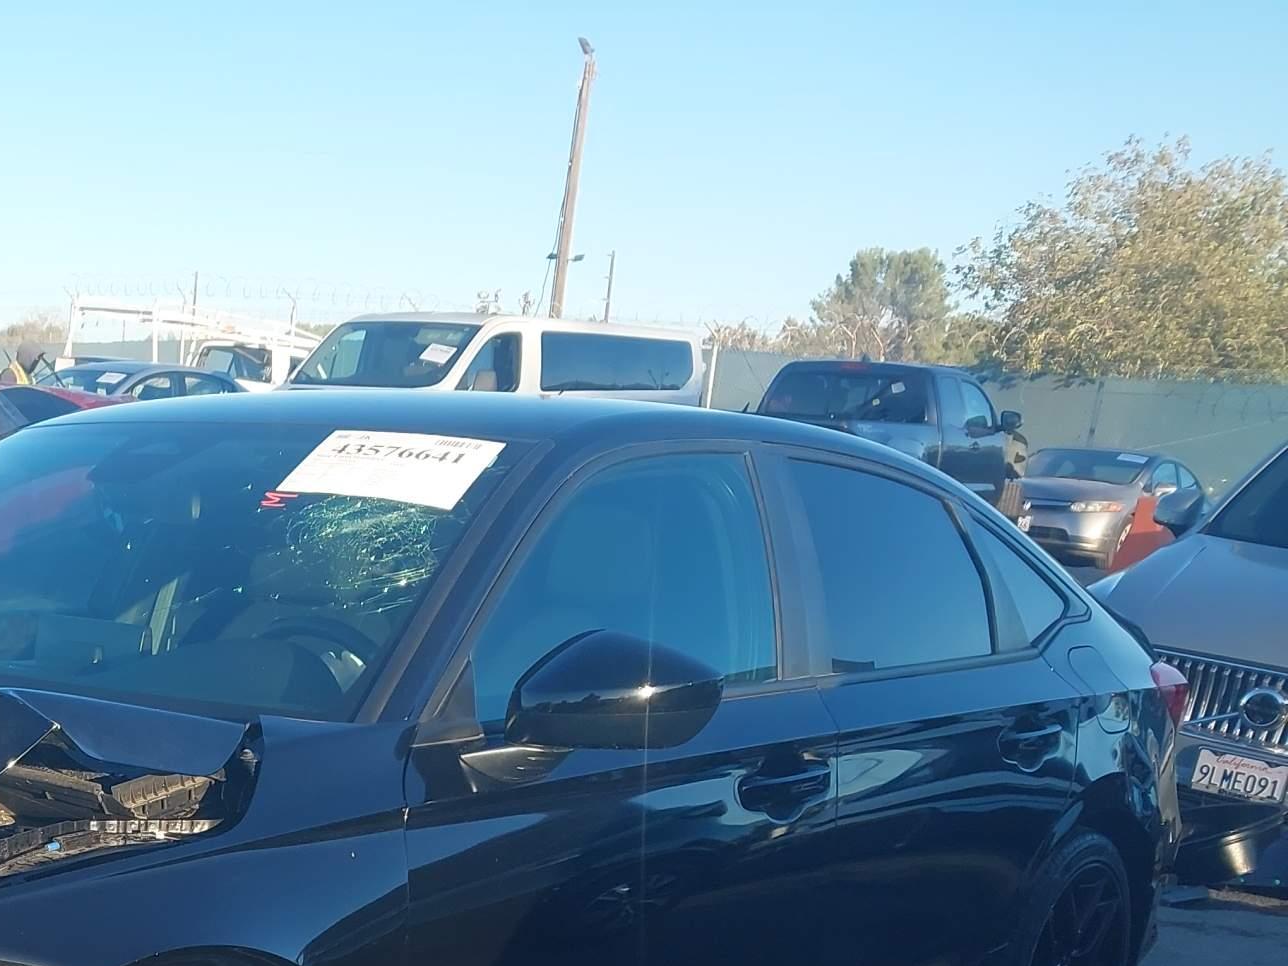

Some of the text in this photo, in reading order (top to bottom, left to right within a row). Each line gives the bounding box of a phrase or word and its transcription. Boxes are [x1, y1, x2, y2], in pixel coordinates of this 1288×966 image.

[331, 442, 466, 464] 43576641
[1216, 754, 1272, 774] California
[1196, 764, 1279, 801] 9LME091
